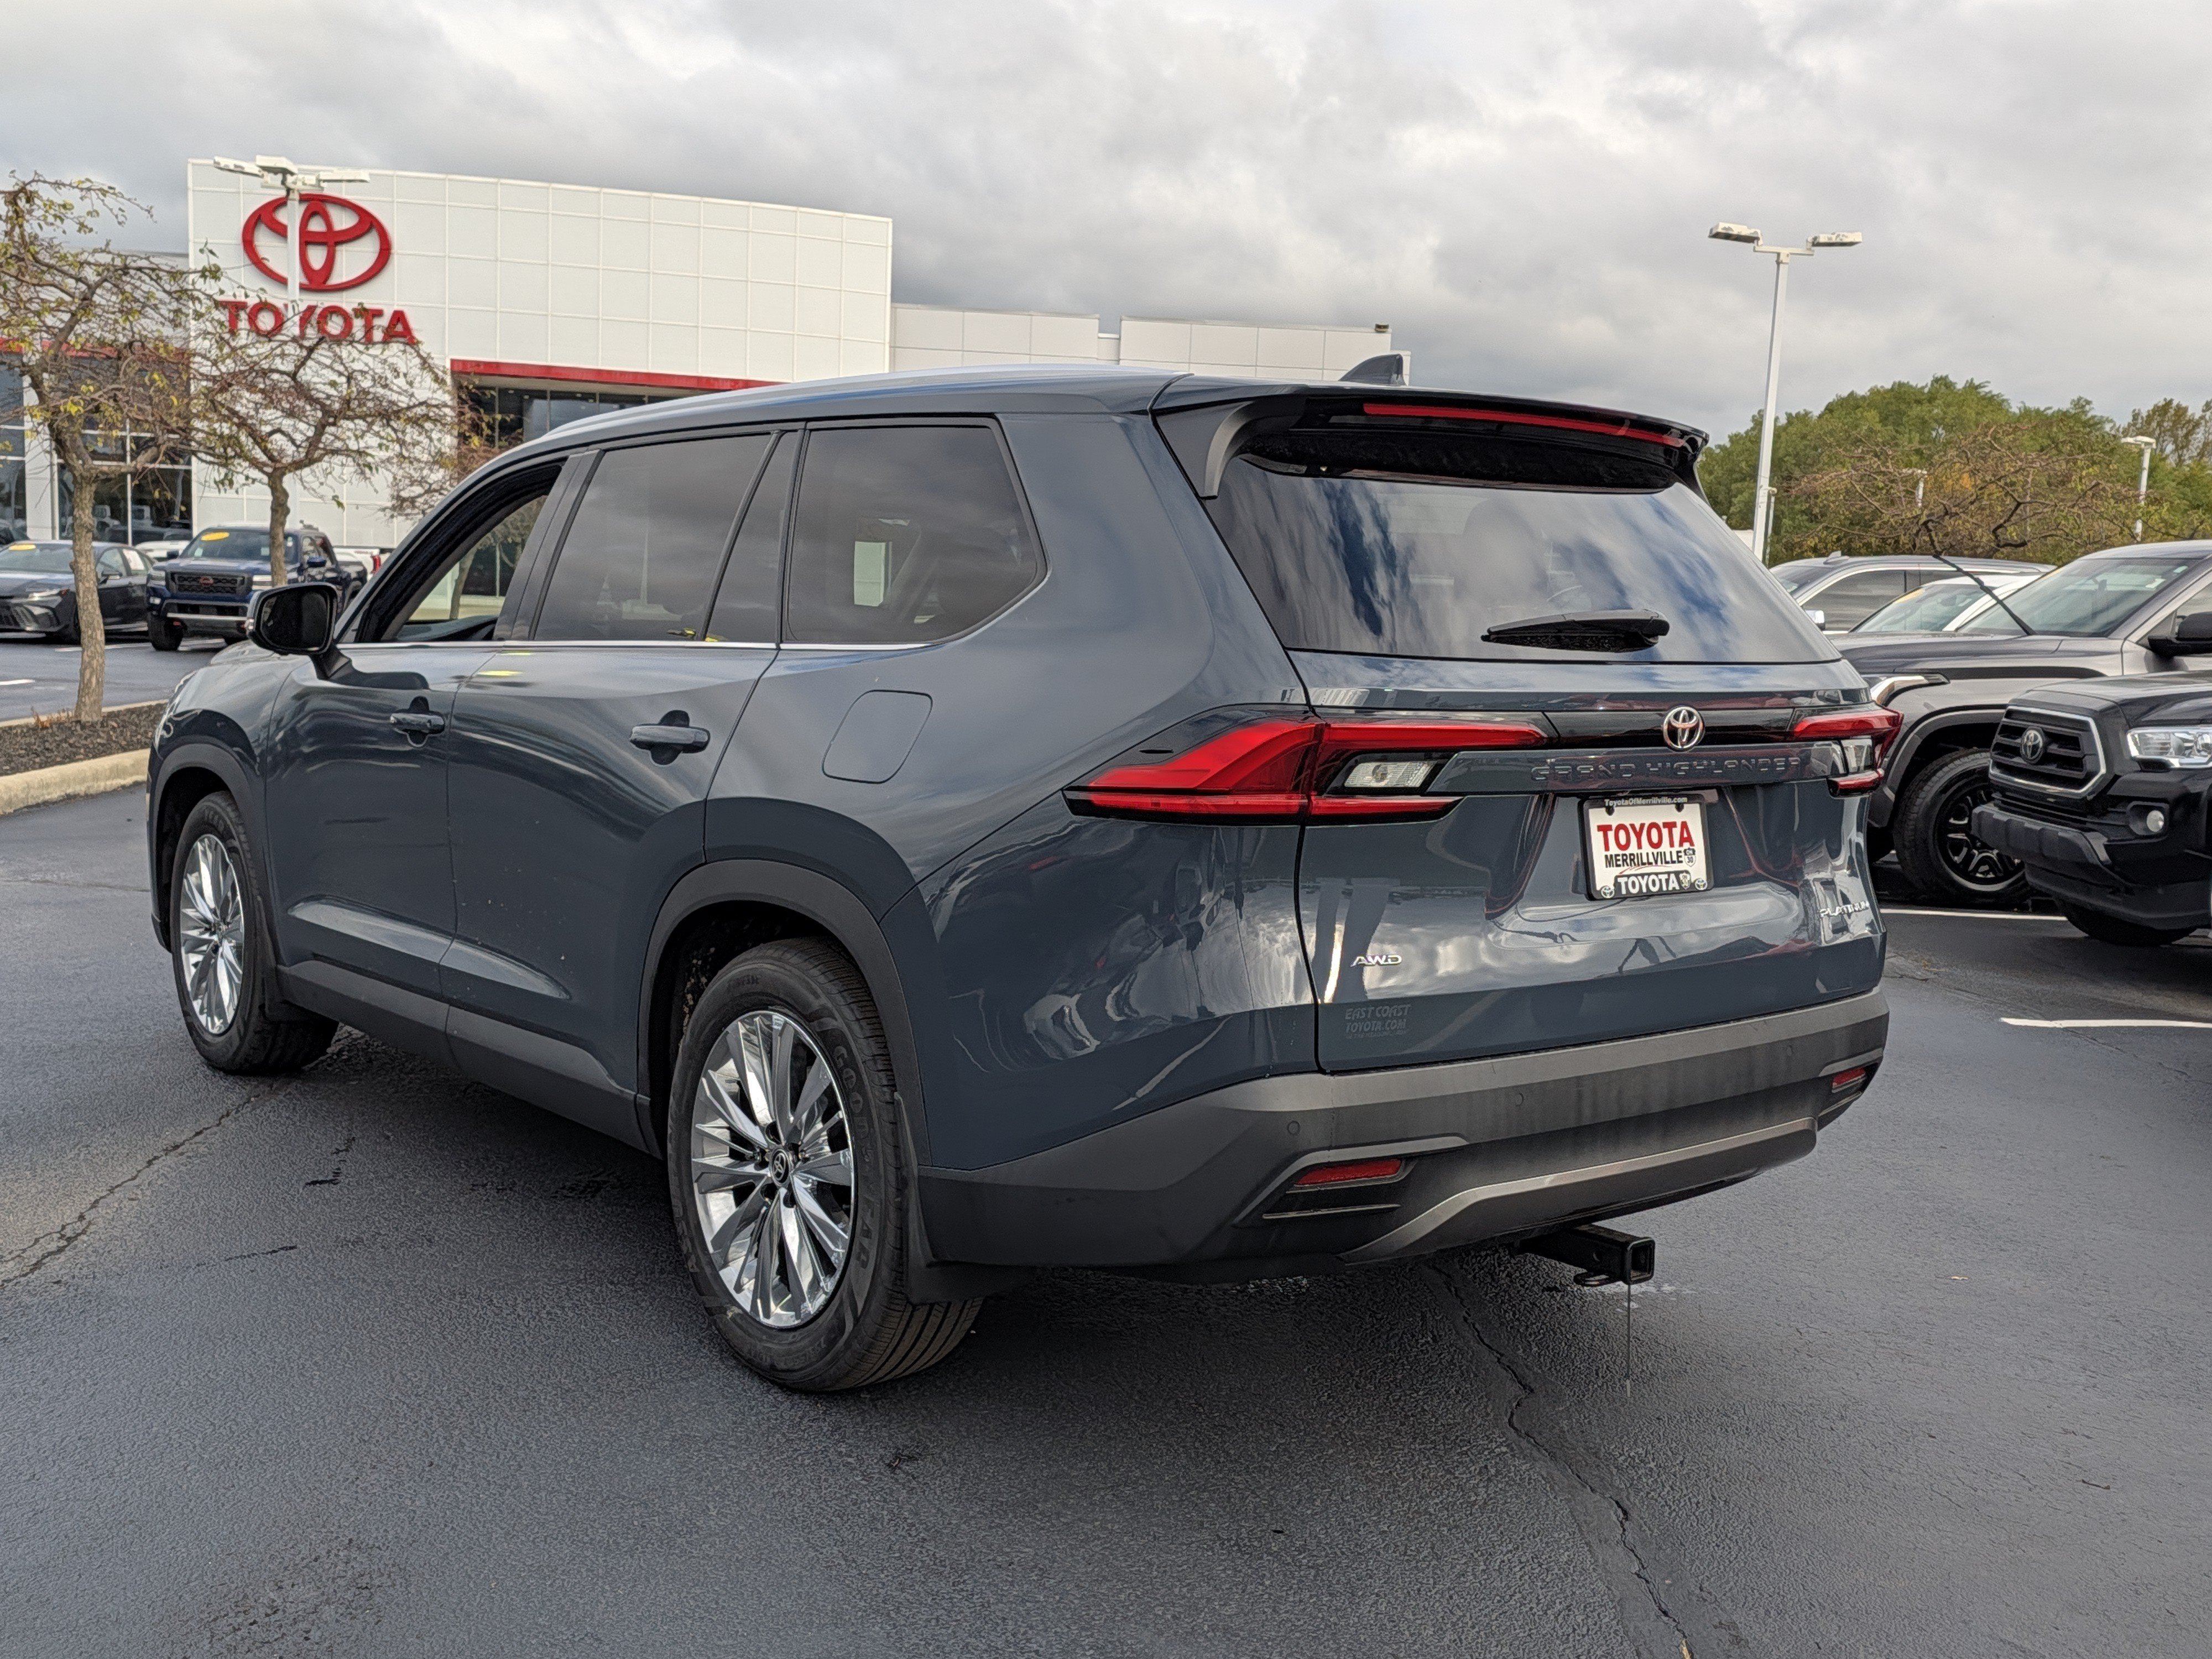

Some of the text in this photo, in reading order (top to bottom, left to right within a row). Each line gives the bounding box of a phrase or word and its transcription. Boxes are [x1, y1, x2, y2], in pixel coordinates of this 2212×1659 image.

[219, 300, 418, 345] TOYOTA
[1531, 757, 1801, 780] GRAND HIGHLANDER
[1597, 821, 1694, 852] TOYOTA
[1605, 850, 1683, 868] MERRILLVILLE
[1618, 873, 1680, 895] TOYOTA
[1819, 901, 1870, 917] PLATINUM
[1350, 954, 1402, 967] AWD
[1345, 1004, 1411, 1020] EAST COAST
[1345, 1019, 1406, 1033] TOYOTA.COM
